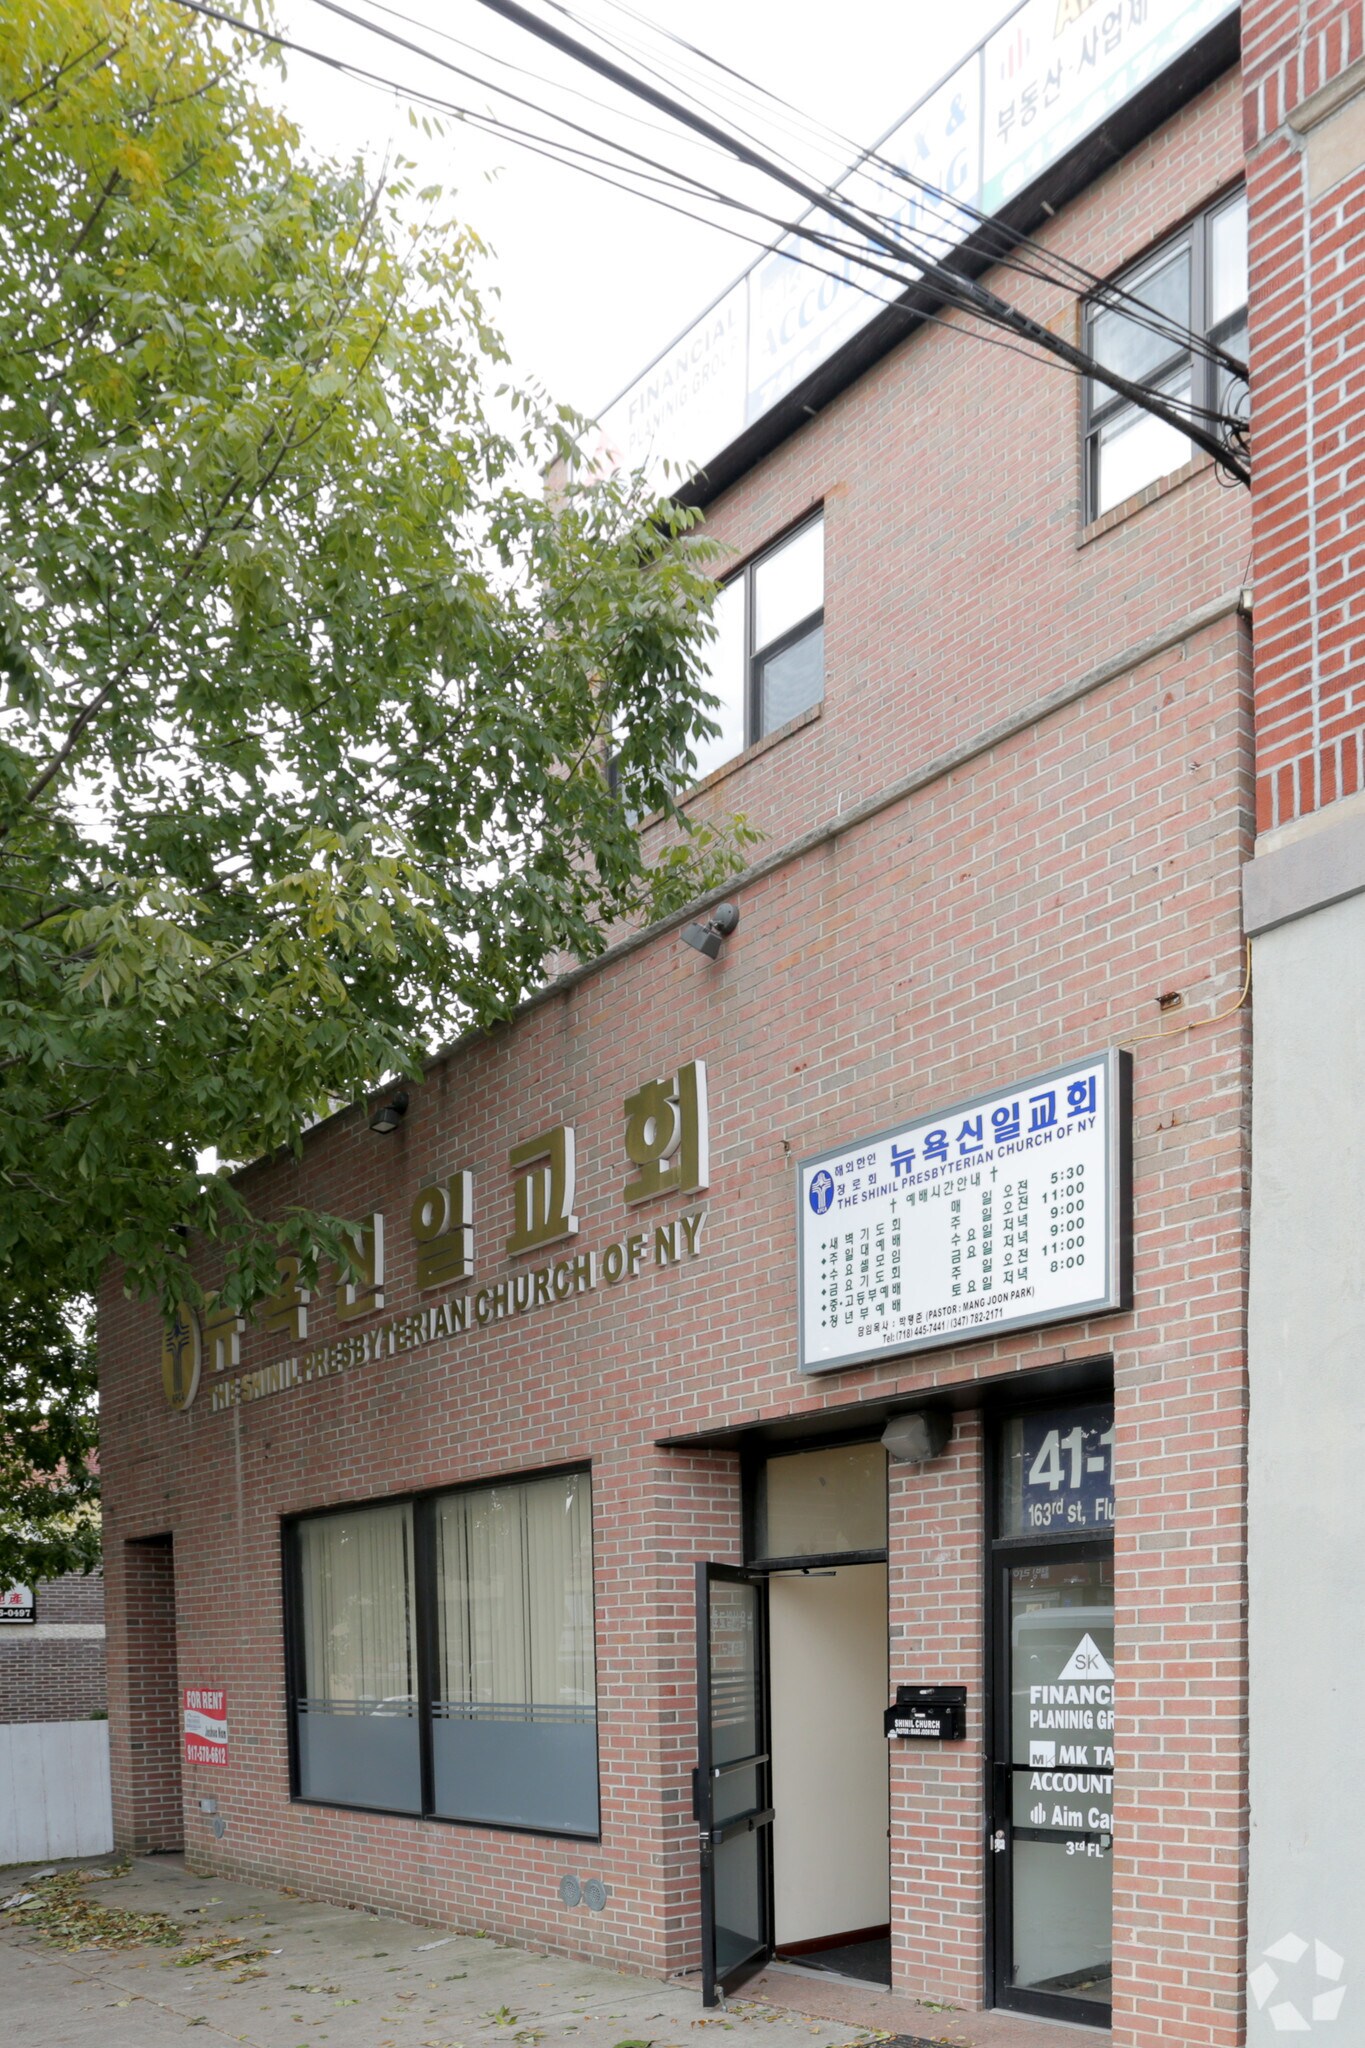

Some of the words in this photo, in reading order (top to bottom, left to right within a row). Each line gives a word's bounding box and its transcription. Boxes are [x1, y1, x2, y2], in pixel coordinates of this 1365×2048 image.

[628, 307, 736, 425] FINANCIAL
[834, 1152, 877, 1177] 해외한인
[890, 1075, 1096, 1178] 뉴욕신일교회
[837, 1194, 859, 1210] THE
[861, 1181, 898, 1202] SHINIL
[901, 1150, 994, 1189] PRESBYTERIAN
[997, 1131, 1052, 1158] CHURCH
[1056, 1123, 1073, 1139] OF
[1077, 1116, 1096, 1132] NY
[1051, 1164, 1085, 1184] 5:30
[836, 1172, 877, 1196] 장로회
[1042, 1181, 1085, 1204] 11:00
[203, 1060, 710, 1372] 뉴욕신일교회
[1050, 1199, 1085, 1219] 9:00
[1050, 1217, 1085, 1236] 9:00
[1042, 1235, 1085, 1256] 11:00
[1050, 1254, 1085, 1273] 8:00
[962, 1297, 985, 1312] MANG
[986, 1291, 1009, 1306] JOON
[1010, 1285, 1035, 1301] PARK)
[208, 1377, 241, 1412] THE
[240, 1357, 303, 1402] SHINIL
[303, 1295, 473, 1381] PRESBYTERIAN
[475, 1250, 597, 1325] CHURCH
[602, 1232, 649, 1283] OF
[655, 1211, 708, 1267] NY
[883, 1332, 896, 1344] Tel:
[896, 1327, 914, 1341] (718)
[950, 1315, 969, 1329] (347)
[970, 1308, 1003, 1324] 782-2171
[1028, 1498, 1064, 1527] 163rd
[1067, 1500, 1086, 1525] st,
[1075, 1653, 1099, 1670] SK
[186, 1690, 201, 1708] FOR
[202, 1691, 223, 1710] RENT
[894, 1719, 914, 1728] SHINIL
[915, 1720, 940, 1729] CHURCH
[1030, 1709, 1093, 1729] PLANINIG
[1096, 1709, 1114, 1730] GR
[1059, 1745, 1088, 1765] MK
[1093, 1745, 1114, 1766] TA
[1029, 1772, 1114, 1794] ACCOUNT
[1051, 1805, 1083, 1828] Aim
[1066, 1841, 1085, 1856] 3rd
[1087, 1843, 1104, 1858] FL
